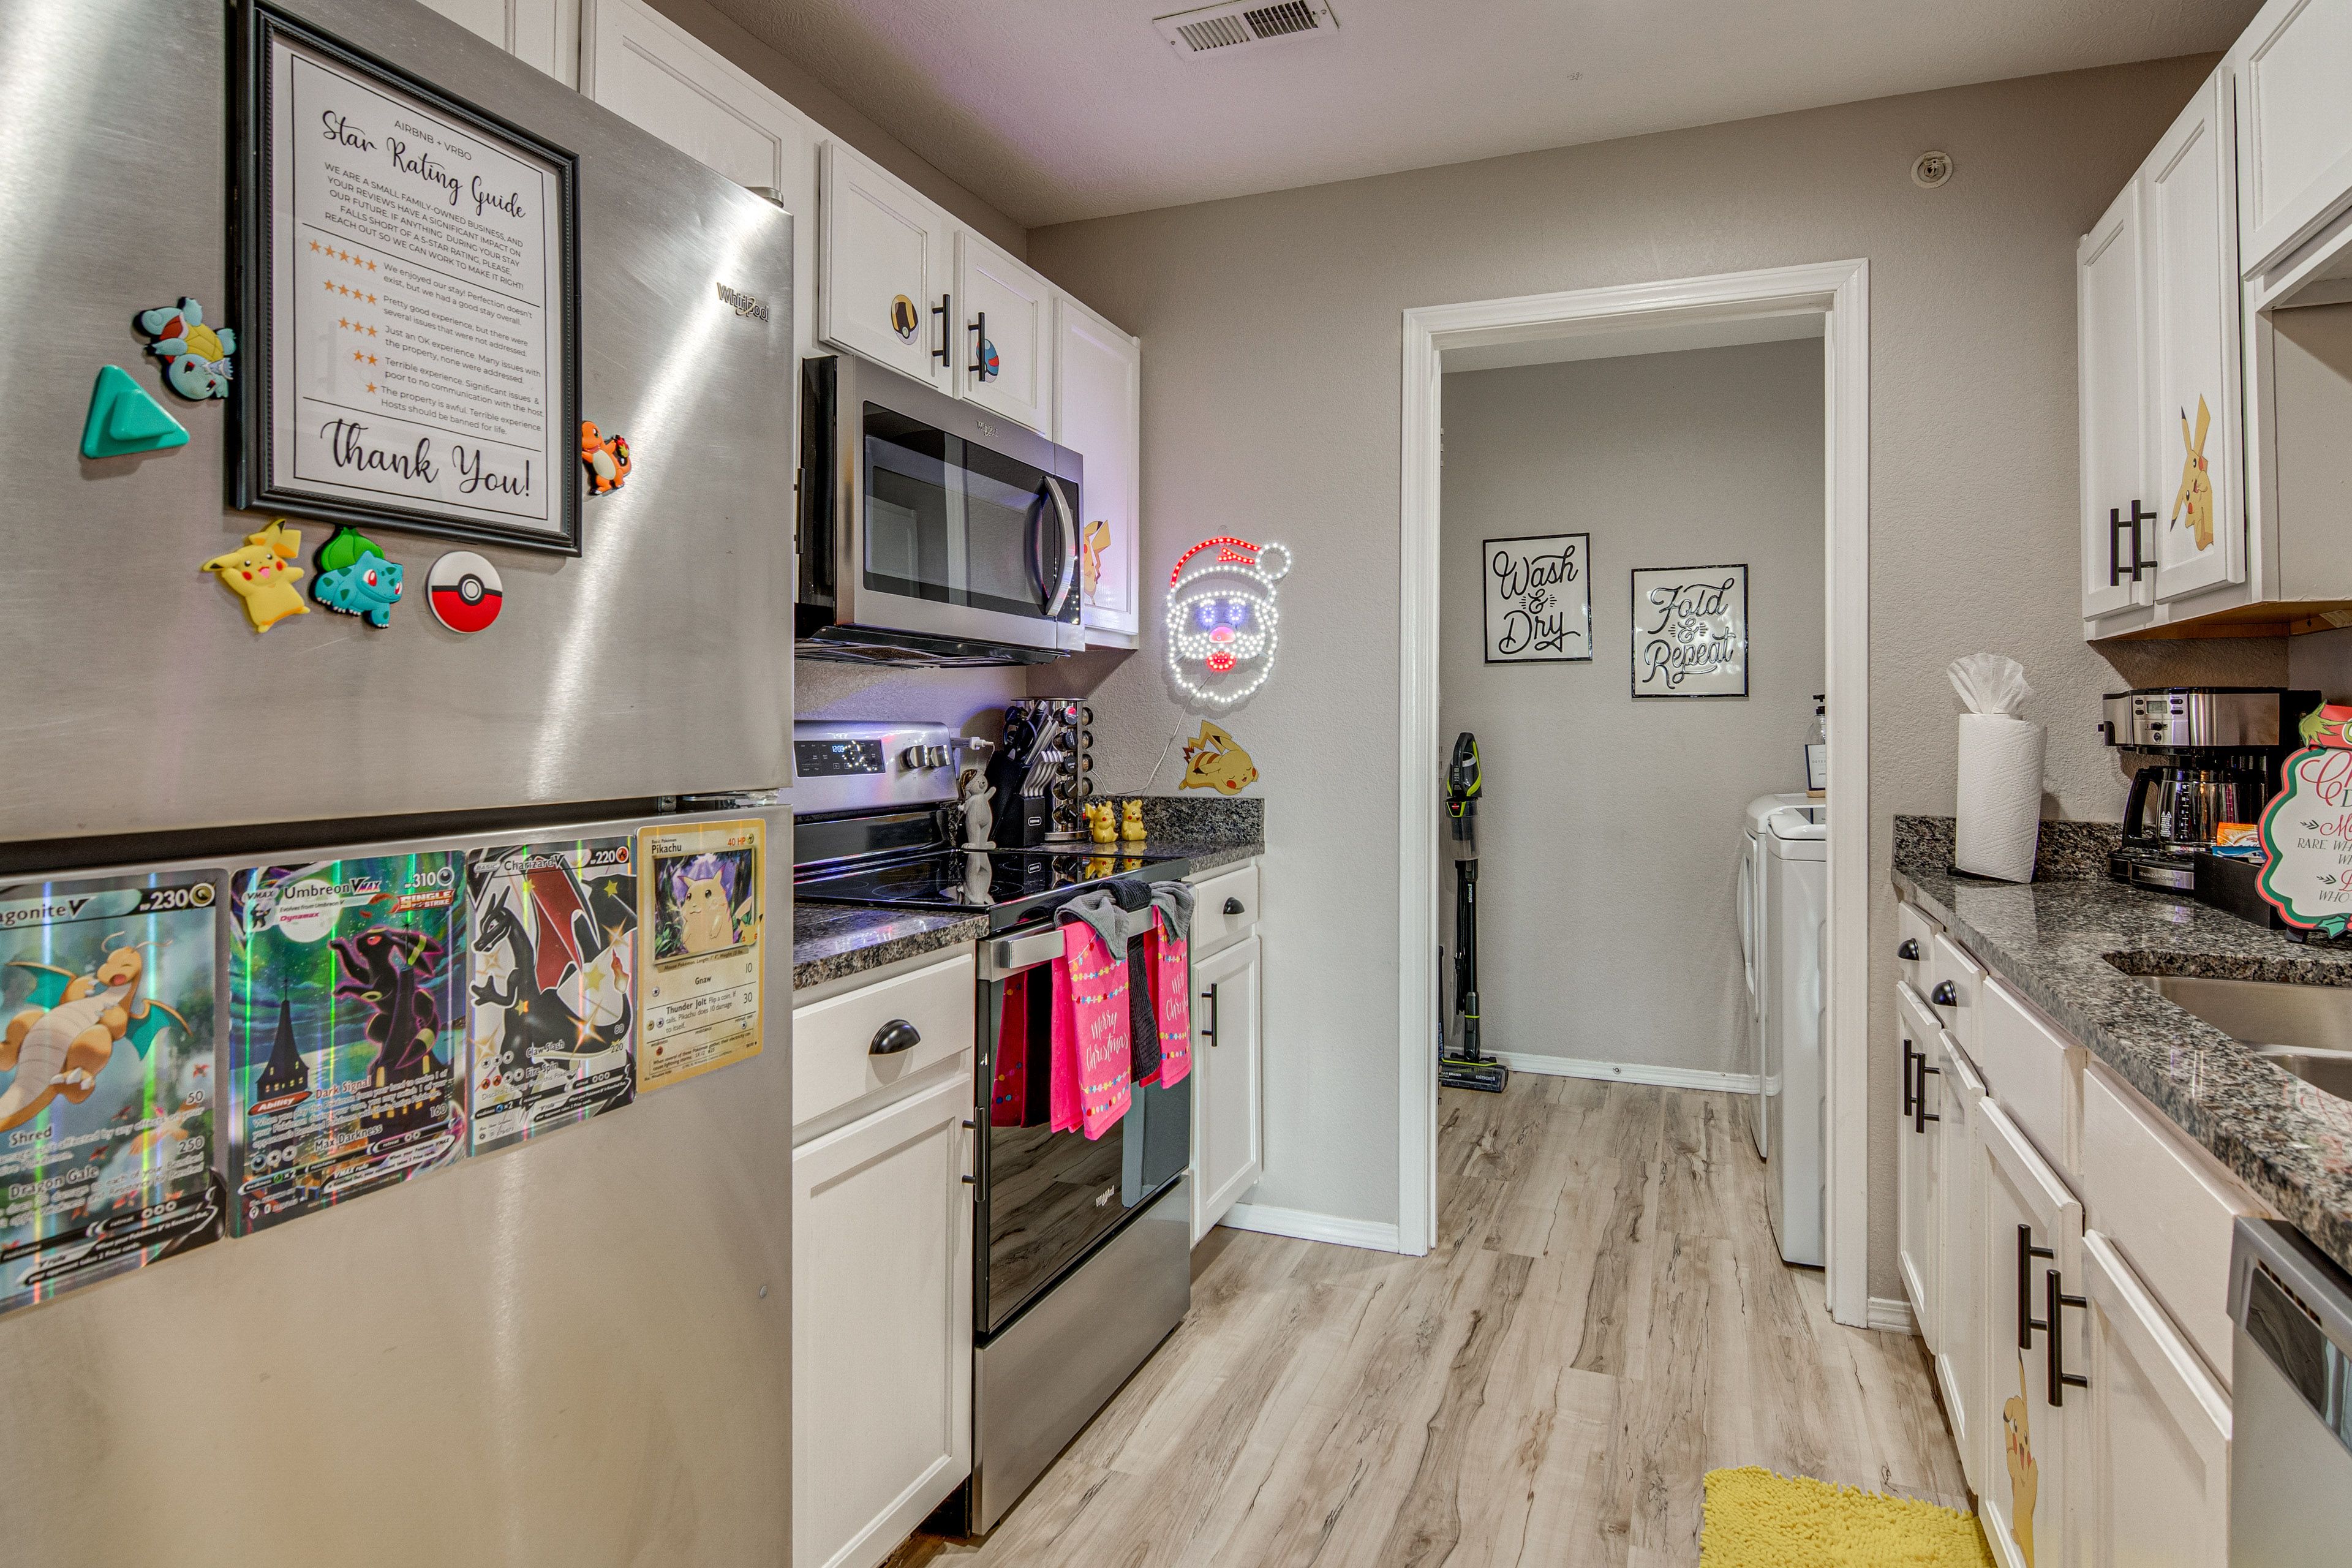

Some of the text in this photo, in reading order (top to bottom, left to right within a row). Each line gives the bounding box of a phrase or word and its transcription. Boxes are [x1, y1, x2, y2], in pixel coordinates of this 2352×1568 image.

[394, 120, 471, 160] AIRBNB VRBO
[322, 110, 524, 217] Star Rating Guide
[325, 162, 522, 247] WE ARE SMALL FAMILY-OWNED AND
[328, 176, 520, 257] YOUR REVIEWS HAVE SIGNIFICANT IMPACT ON
[330, 189, 350, 202] OUR
[401, 217, 442, 238] ANYTHING
[447, 234, 477, 251] DURING
[479, 247, 500, 259] YOUR
[502, 255, 519, 266] STAY
[341, 205, 367, 221] FALLS
[369, 216, 398, 232] SHORT
[421, 236, 448, 251] 5-STAR
[325, 212, 523, 289] REACH OUT SO WE CAN WORK TO MAKE RIGHT!
[383, 263, 397, 273] We
[399, 270, 431, 284] enjoyed
[448, 286, 465, 296] stay!
[467, 291, 504, 309] Perfection
[507, 306, 532, 318] doesn't
[406, 282, 419, 292] but
[435, 292, 450, 302] had
[459, 301, 478, 311] good
[480, 308, 494, 317] stay
[717, 282, 769, 322] Whirlpool
[383, 295, 407, 309] Pretty
[410, 305, 429, 315] good
[476, 325, 488, 334] but
[490, 330, 509, 340] there
[511, 337, 527, 346] were
[383, 308, 411, 321] several
[413, 318, 435, 329] issues
[437, 325, 453, 334] that
[454, 331, 473, 341] were
[385, 325, 402, 336] Just
[418, 336, 429, 345] OK
[478, 354, 499, 366] Many
[502, 360, 523, 372] issues
[385, 339, 399, 348] the
[440, 356, 460, 366] none
[462, 363, 481, 372] were
[385, 356, 418, 372] Terrible
[466, 380, 506, 396] Significant
[509, 391, 530, 402] issues
[385, 371, 405, 380] poor
[431, 383, 491, 404] communication
[381, 385, 398, 396] The
[400, 392, 435, 406] property
[469, 408, 499, 421] Terrible
[382, 399, 405, 410] Hosts
[408, 405, 436, 417] should
[450, 415, 478, 428] banned
[320, 418, 529, 496] Thank You!
[1493, 545, 1578, 600] Wash
[1527, 589, 1548, 613] &
[1648, 578, 1735, 635] Fold
[1498, 610, 1581, 654] Dry
[1677, 618, 1699, 643] &
[1643, 626, 1736, 689] Repeat
[652, 843, 682, 854] Pikachu
[728, 837, 745, 846] 40 HP
[2297, 837, 2328, 850] RARE
[504, 858, 554, 871] Charizard
[595, 850, 616, 864] 220
[284, 878, 381, 899] Umbreon VMAX
[412, 872, 435, 889] 310
[151, 890, 189, 910] 230
[247, 890, 274, 900] VMAX
[424, 899, 450, 908] STRIKE
[280, 911, 319, 922] Dynamax
[745, 962, 753, 973] 10
[695, 976, 711, 985] Gnaw
[666, 998, 707, 1015] Thunder Jolt
[743, 992, 753, 1004] 30
[678, 1002, 732, 1021] Pikachu damage
[614, 1023, 624, 1035] 80
[1091, 1009, 1117, 1040] Merry
[526, 1039, 565, 1058] Claw Slash
[611, 1044, 624, 1054] 220
[1087, 1033, 1128, 1072] Christmas
[541, 1061, 559, 1073] Spin
[187, 1090, 204, 1105] 50
[315, 1085, 339, 1099] Dark
[342, 1075, 372, 1094] Signal
[259, 1096, 295, 1112] Ability
[430, 1104, 448, 1118] 160
[9, 1126, 52, 1147] Shred
[178, 1136, 205, 1153] 250
[314, 1139, 336, 1153] Max
[338, 1125, 383, 1145] Darkness
[9, 1176, 66, 1200] Dragon
